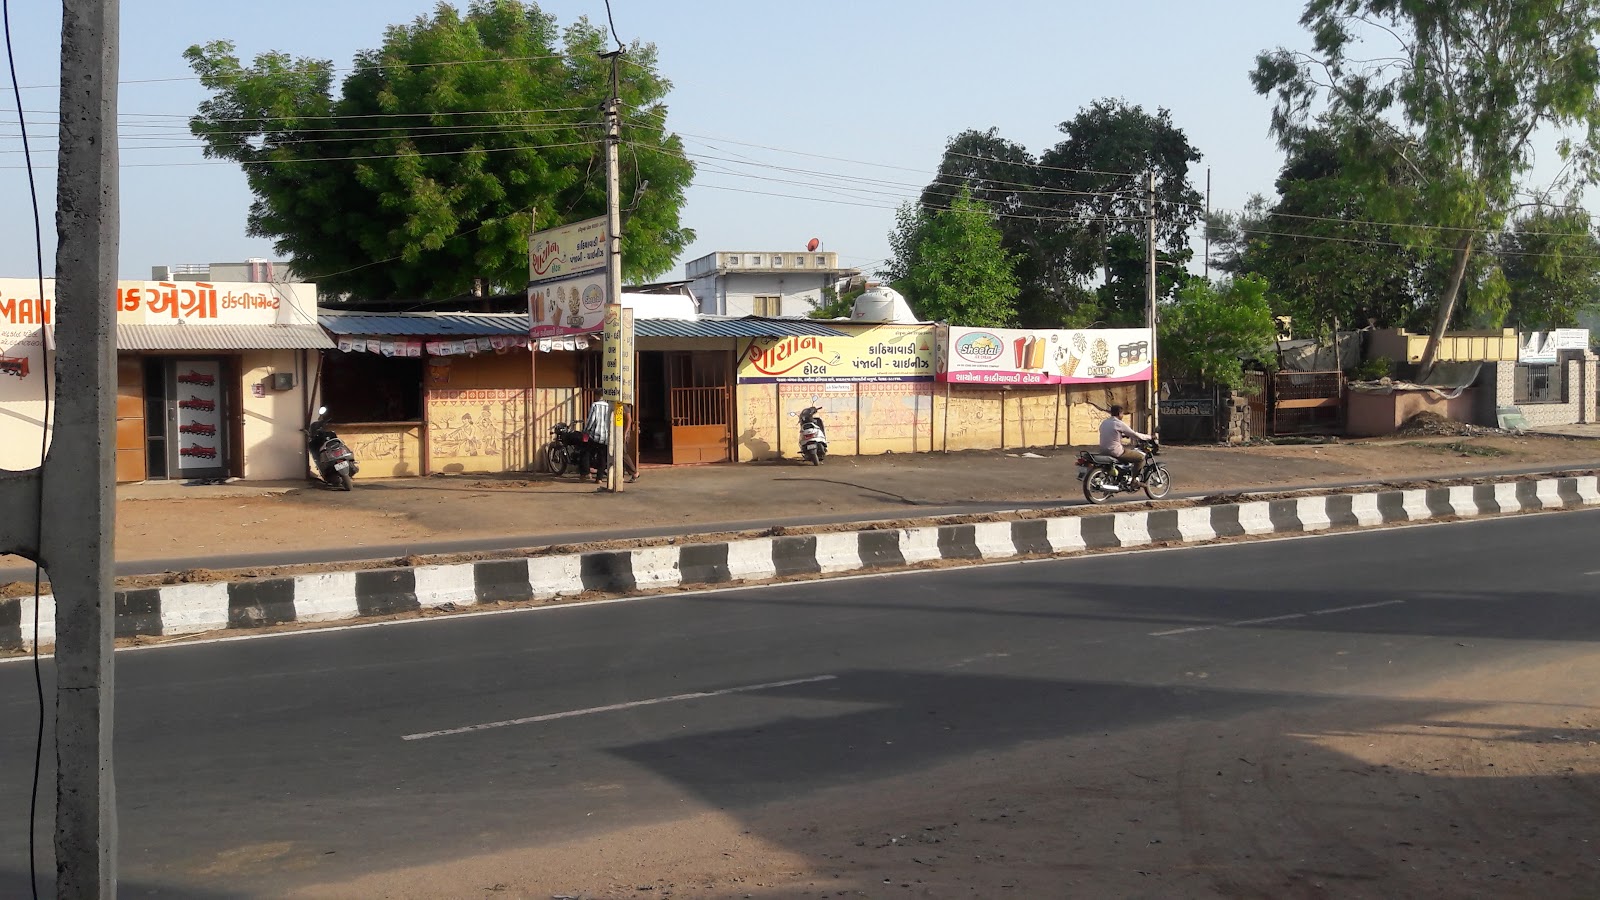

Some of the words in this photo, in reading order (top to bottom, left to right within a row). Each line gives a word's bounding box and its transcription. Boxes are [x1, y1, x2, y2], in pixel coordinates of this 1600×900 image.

[146, 282, 218, 318] એગ્રો
[868, 342, 917, 355] કાઠિયાવાડી
[961, 343, 998, 356] Sheetal
[803, 362, 827, 375] હોટલ
[852, 356, 882, 369] પંજાબી
[955, 372, 981, 382] શાયોના
[1022, 374, 1041, 383] હોટલ
